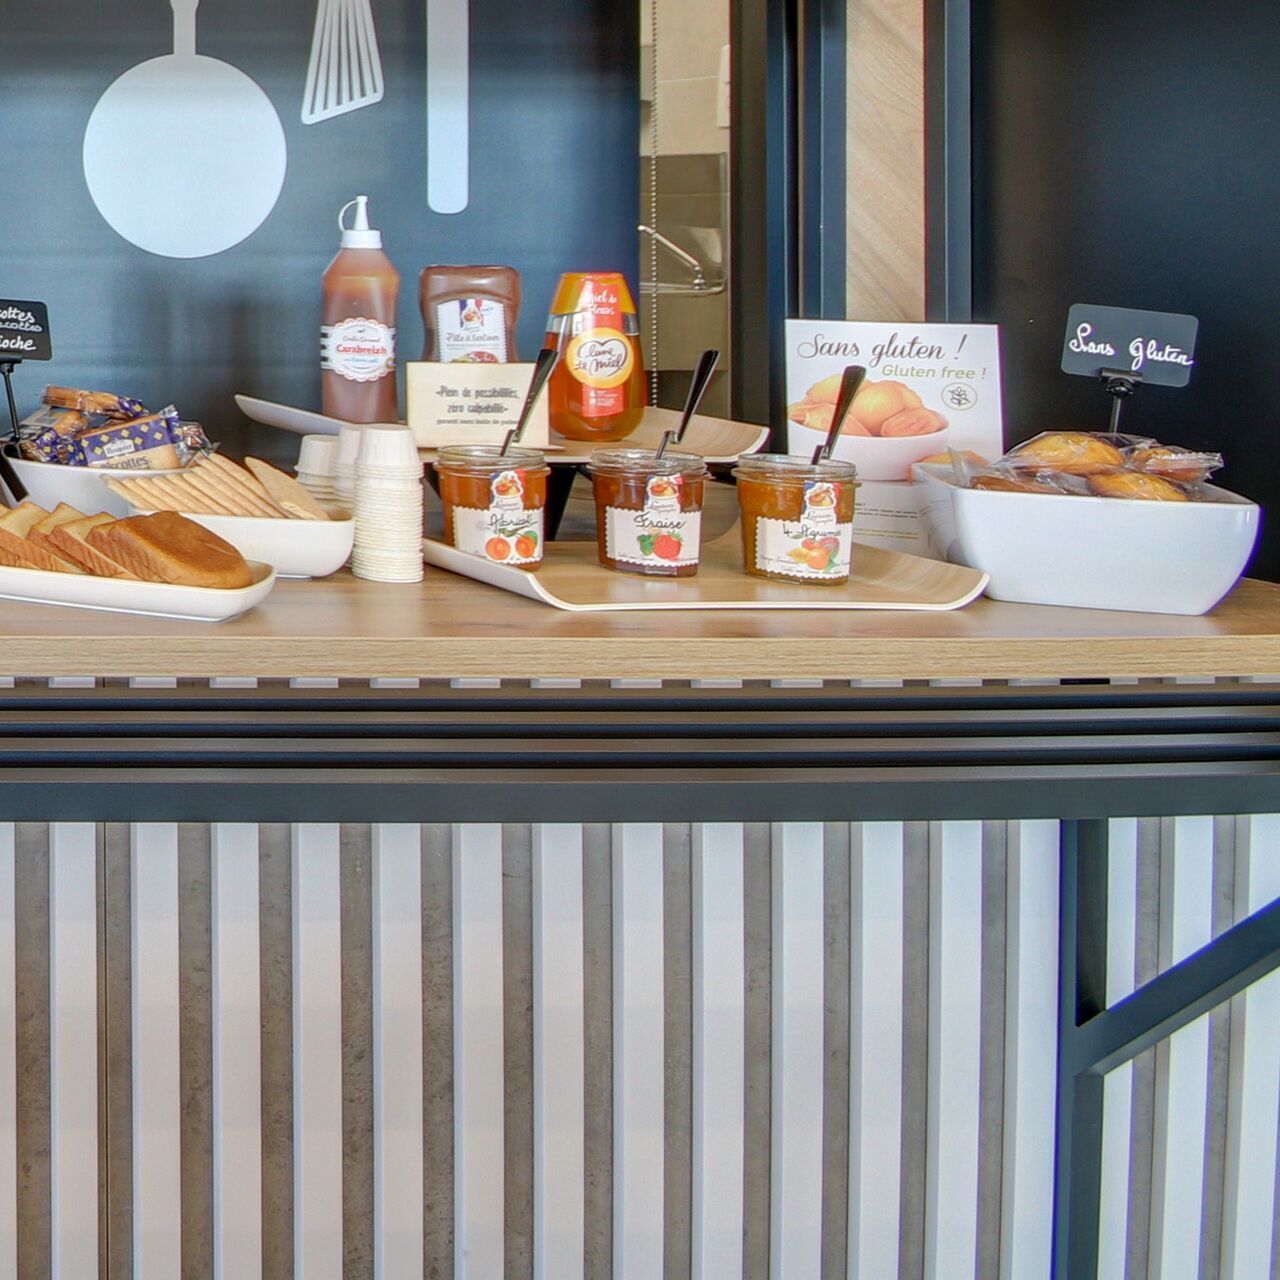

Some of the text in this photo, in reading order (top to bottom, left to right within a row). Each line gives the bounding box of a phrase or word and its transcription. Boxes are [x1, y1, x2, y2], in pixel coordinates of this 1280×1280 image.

[797, 333, 860, 361] Sans
[871, 337, 946, 369] gluten
[1069, 322, 1195, 370] Sans Gluten
[883, 364, 937, 381] Gluten
[942, 367, 976, 380] free
[633, 511, 686, 529] Fraise
